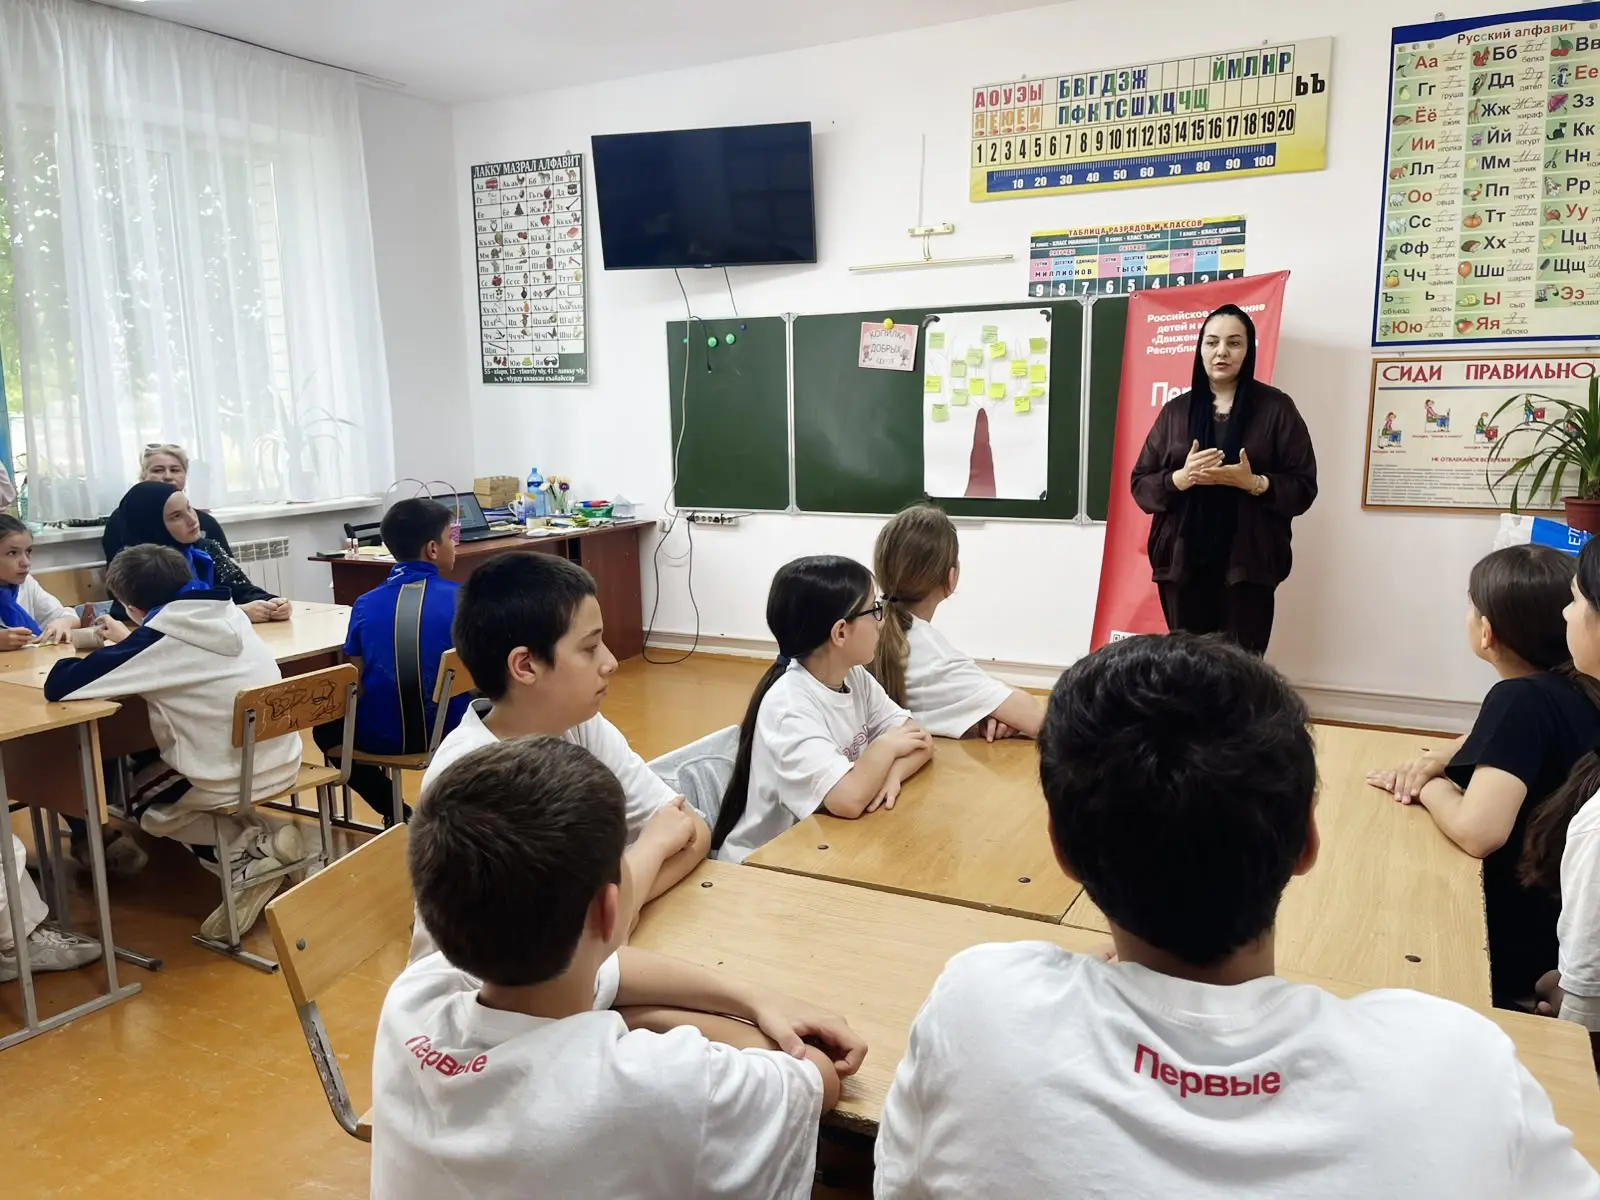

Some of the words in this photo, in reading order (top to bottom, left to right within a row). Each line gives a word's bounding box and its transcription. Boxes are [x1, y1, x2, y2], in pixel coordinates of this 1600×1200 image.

[1457, 29, 1510, 46] Русский
[1515, 23, 1576, 37] алфавит
[1493, 45, 1517, 61] Бб
[1415, 56, 1438, 69] Аа
[1575, 65, 1598, 80] Ее
[1488, 73, 1514, 90] Дд
[1419, 82, 1436, 96] Гг
[1572, 94, 1594, 108] Зз
[1416, 106, 1437, 123] Ёё
[1481, 103, 1510, 117] Жж
[977, 144, 982, 162] 1
[991, 143, 997, 161] 2
[1005, 141, 1012, 160] 3
[1019, 139, 1026, 159] 4
[1034, 138, 1042, 157] 5
[1050, 136, 1056, 156] 6
[1066, 134, 1072, 154] 7
[1080, 132, 1087, 152] 8
[1096, 131, 1103, 150] 9
[1109, 129, 1121, 149] 10
[1126, 127, 1137, 147] 11
[1141, 125, 1154, 146] 12
[1158, 123, 1170, 144] 13
[1174, 121, 1187, 142] 14
[1191, 119, 1204, 141] 15
[1209, 117, 1222, 139] 16
[1226, 115, 1239, 137] 17
[1243, 113, 1257, 135] 18
[1261, 111, 1275, 133] 19
[1278, 109, 1294, 131] 20
[1488, 127, 1511, 144] Йй
[1574, 122, 1595, 136] Кк
[1412, 137, 1434, 151] Ии
[1481, 156, 1510, 170] Мм
[1565, 149, 1590, 163] Нн
[474, 163, 501, 177] ЛАККУ
[503, 160, 536, 175] МАЗРАЛ
[539, 155, 580, 171] АЛФАВИТ
[1012, 178, 1023, 189] 10
[1035, 177, 1047, 187] 20
[1060, 175, 1073, 185] 30
[1086, 172, 1099, 183] 40
[1113, 169, 1127, 180] 50
[1140, 167, 1154, 177] 60
[1169, 164, 1181, 175] 70
[1196, 161, 1210, 172] 80
[1226, 158, 1240, 169] 90
[1254, 155, 1274, 167] 100
[1409, 162, 1434, 175] Лл
[1486, 183, 1509, 197] Пп
[1566, 178, 1590, 194] Рр
[1408, 189, 1432, 203] Оо
[1485, 210, 1506, 223] Тт
[1566, 204, 1588, 221] Уу
[1069, 227, 1106, 236] ТАБЛИЦА
[1108, 224, 1151, 234] РАЗРЯДОВ
[1163, 220, 1202, 228] КЛАССОВ
[1409, 215, 1431, 228] Сс
[1484, 236, 1506, 249] Хх
[1561, 229, 1586, 245] Цц
[1400, 241, 1429, 257] Фф
[1474, 265, 1504, 277] Шш
[1554, 259, 1586, 274] Щщ
[1404, 268, 1426, 281] Чч
[1036, 284, 1044, 296] 9
[1058, 283, 1066, 295] 8
[1082, 282, 1089, 294] 7
[1106, 280, 1114, 293] 6
[1127, 279, 1135, 292] 5
[1152, 278, 1160, 289] 4
[1176, 276, 1185, 286] 3
[1561, 286, 1584, 300] Ээ
[1383, 292, 1393, 302] Ъ
[1426, 291, 1435, 300] Ь
[1484, 292, 1500, 305] Ы
[1147, 311, 1209, 323] Российское
[1476, 317, 1500, 330] Яя
[1157, 322, 1187, 334] детей
[1392, 321, 1422, 334] Юю
[870, 330, 906, 342] КОПИЛКА
[871, 344, 902, 353] ДОБРЫХ
[1382, 365, 1442, 383] СИДИ
[1465, 361, 1595, 380] ПРАВИЛЬНО
[405, 1035, 487, 1076] Первые
[1134, 1044, 1280, 1098] Первые
